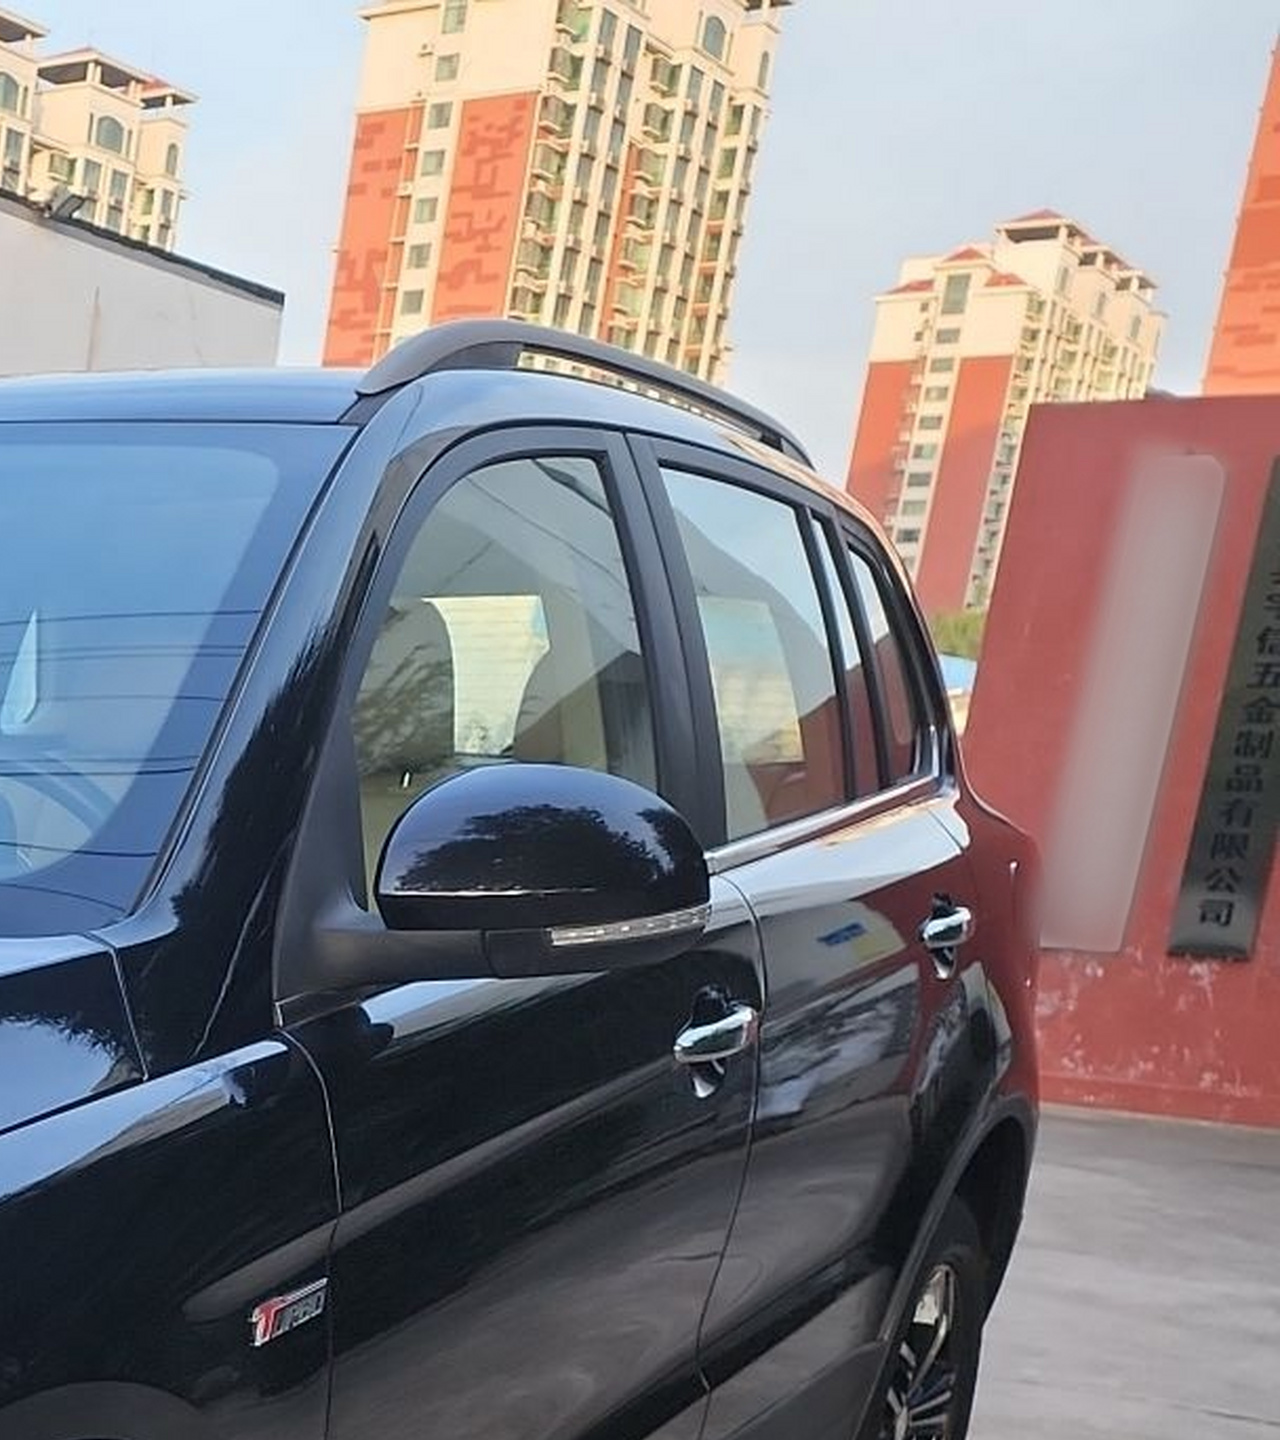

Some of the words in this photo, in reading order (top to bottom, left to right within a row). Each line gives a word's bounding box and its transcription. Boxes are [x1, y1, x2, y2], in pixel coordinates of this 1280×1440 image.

[1199, 570, 1280, 927] 信五金制品有限公司
